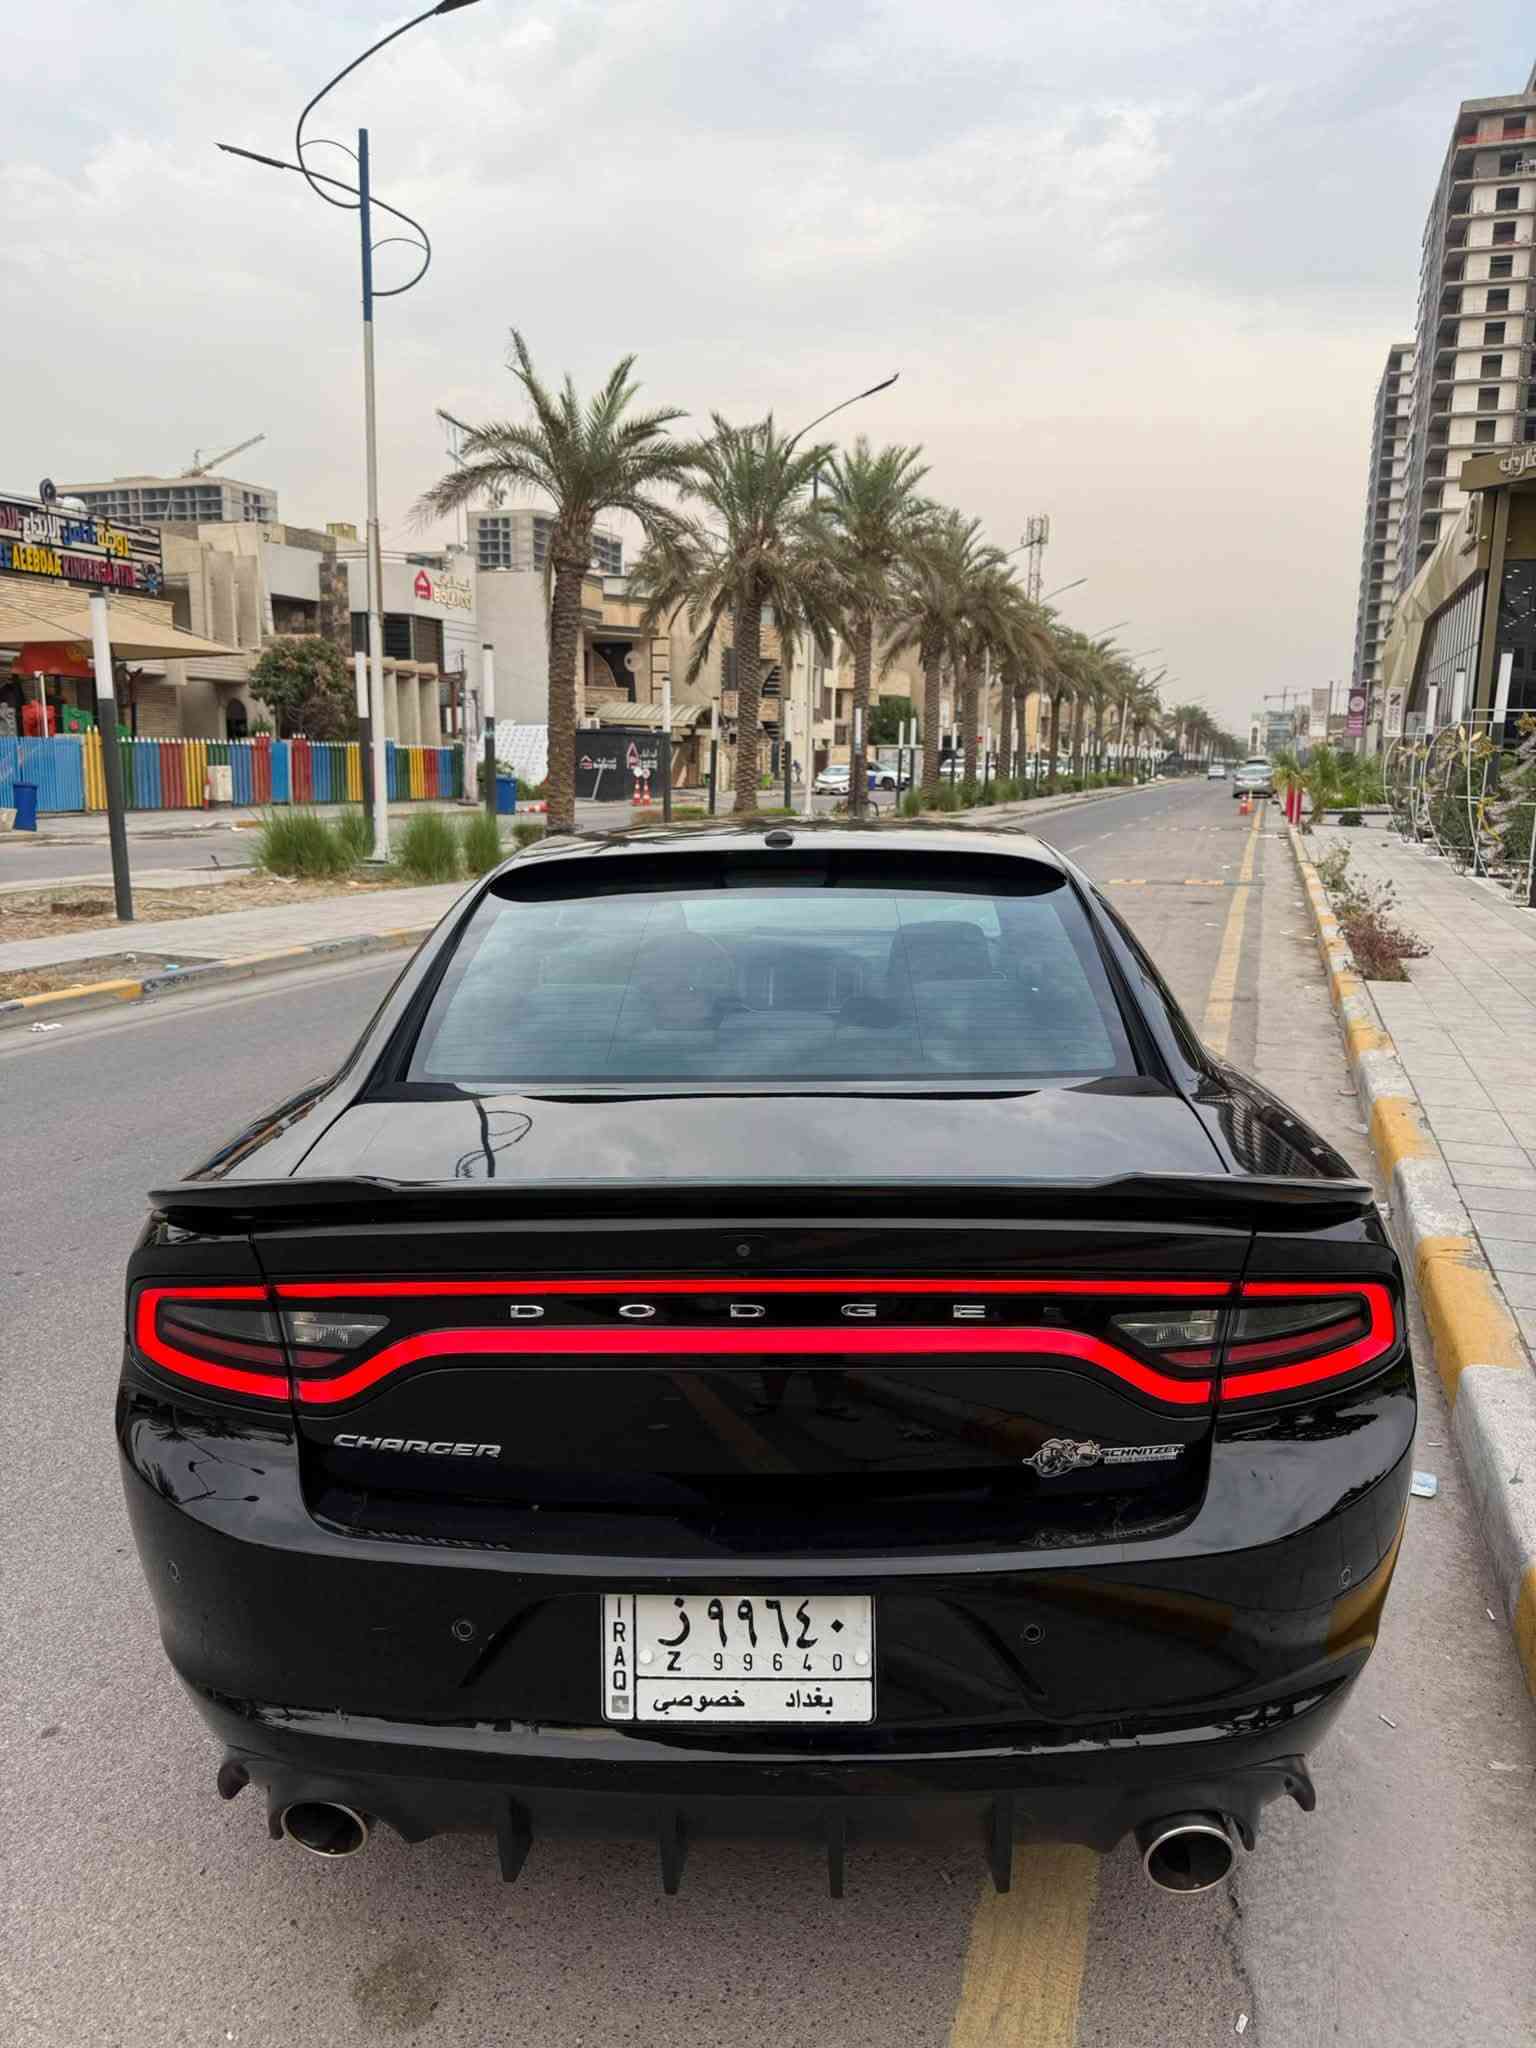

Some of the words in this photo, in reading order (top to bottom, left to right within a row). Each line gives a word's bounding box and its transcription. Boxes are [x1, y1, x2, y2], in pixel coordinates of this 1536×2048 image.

[510, 1303, 986, 1319] DODGE
[333, 1433, 502, 1458] CHARGER
[612, 1597, 627, 1691] IRAQ
[666, 1651, 682, 1672] Z
[653, 1689, 746, 1715] خصوصي
[785, 1687, 834, 1715] بغداد
